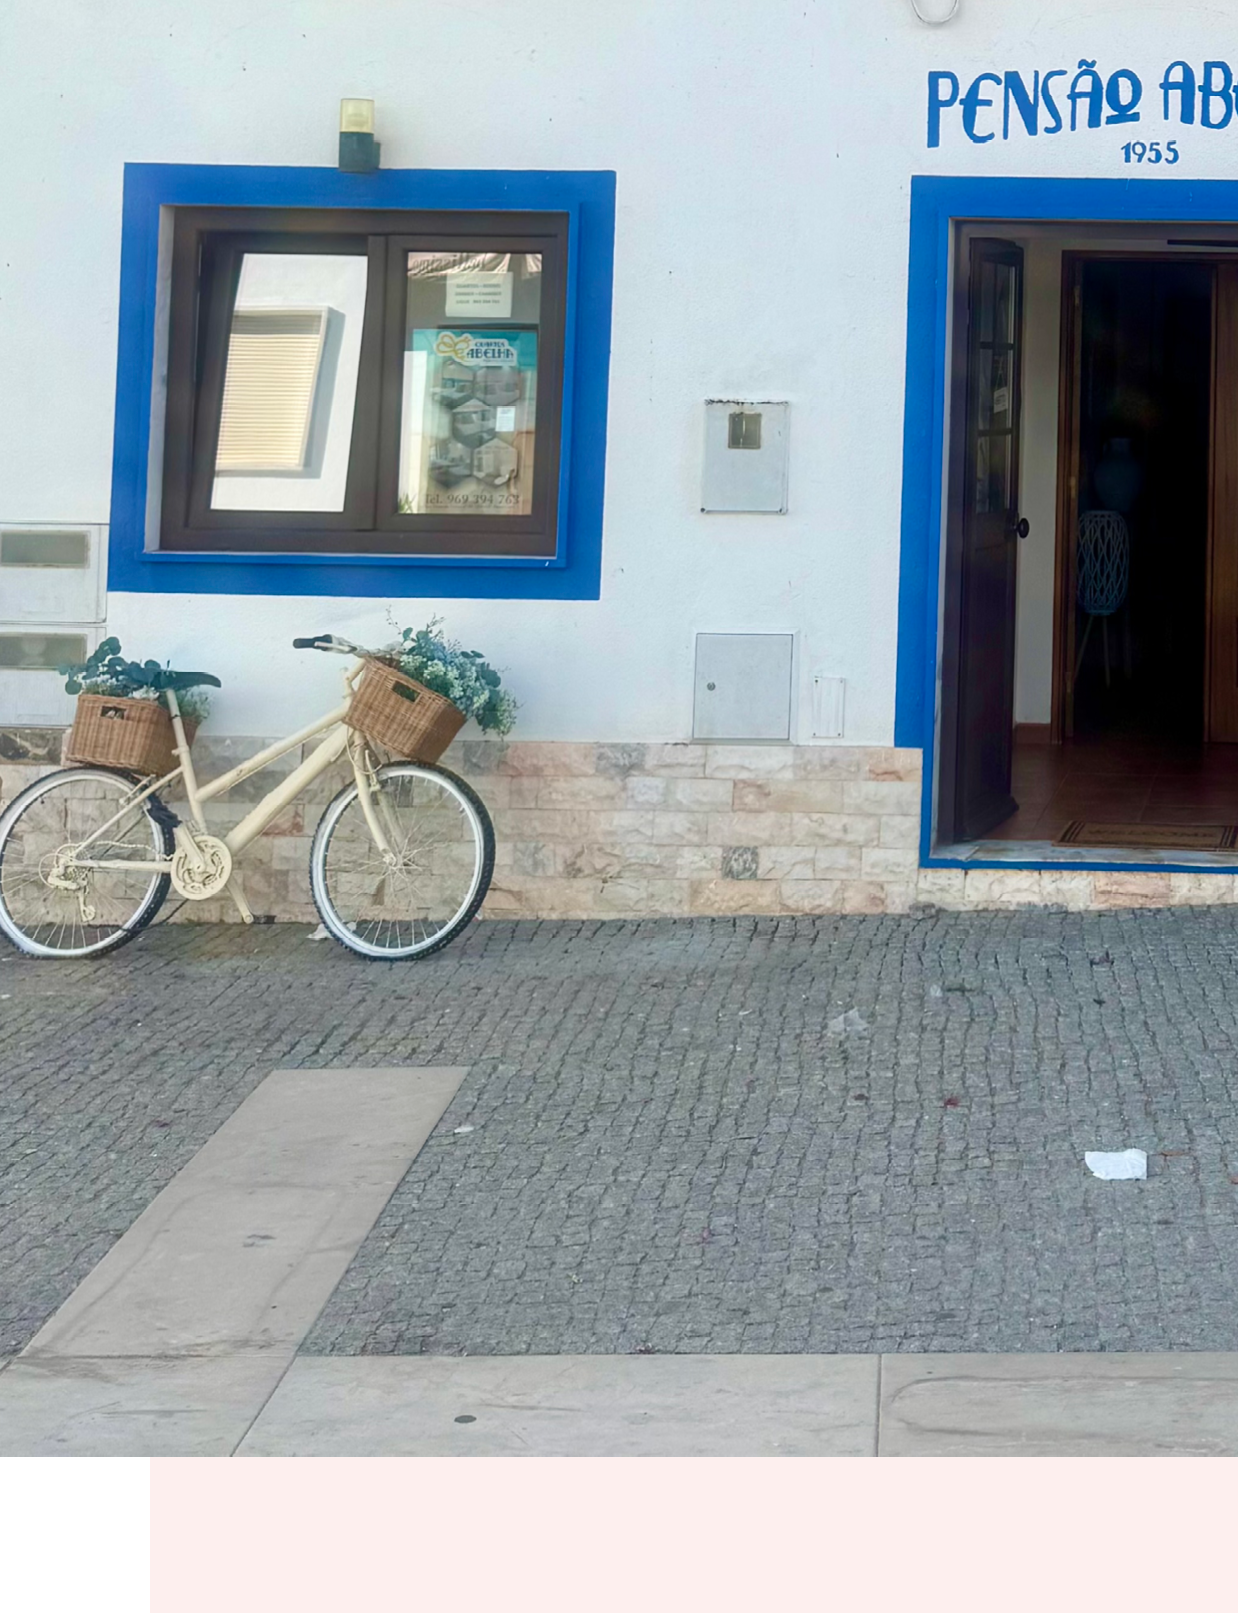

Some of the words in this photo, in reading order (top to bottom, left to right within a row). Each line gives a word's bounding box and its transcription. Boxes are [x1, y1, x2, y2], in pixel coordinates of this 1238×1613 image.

[926, 59, 1143, 149] PENSÃO
[1120, 139, 1180, 165] 1955
[466, 348, 515, 359] ABELHA
[447, 494, 469, 505] 969
[472, 494, 494, 504] 394
